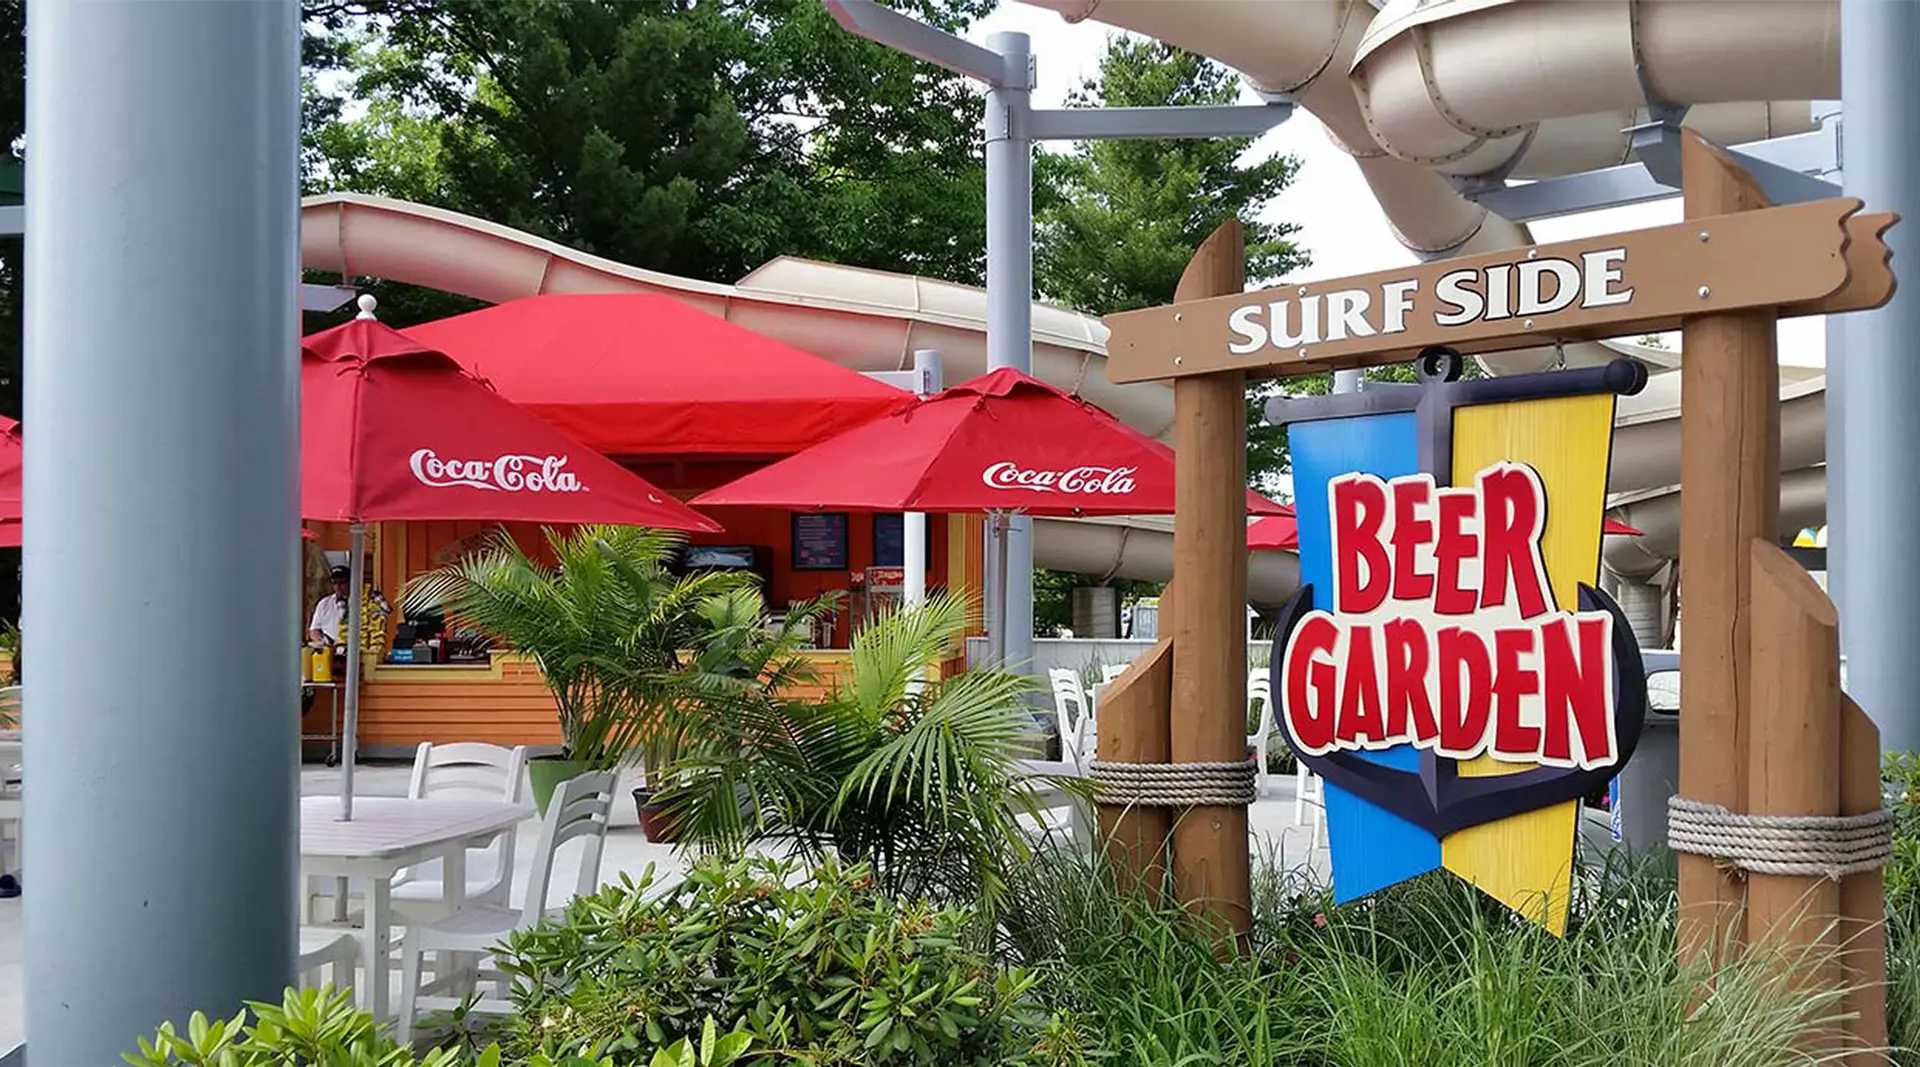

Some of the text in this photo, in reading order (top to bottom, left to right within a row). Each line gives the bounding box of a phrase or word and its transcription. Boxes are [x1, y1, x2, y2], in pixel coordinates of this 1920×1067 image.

[1227, 247, 1634, 356] SURF SIDE
[409, 448, 582, 492] Coca-Cola
[982, 461, 1139, 494] Coca-Cola
[1332, 465, 1550, 621] BEER
[1286, 614, 1612, 763] GARDEN
